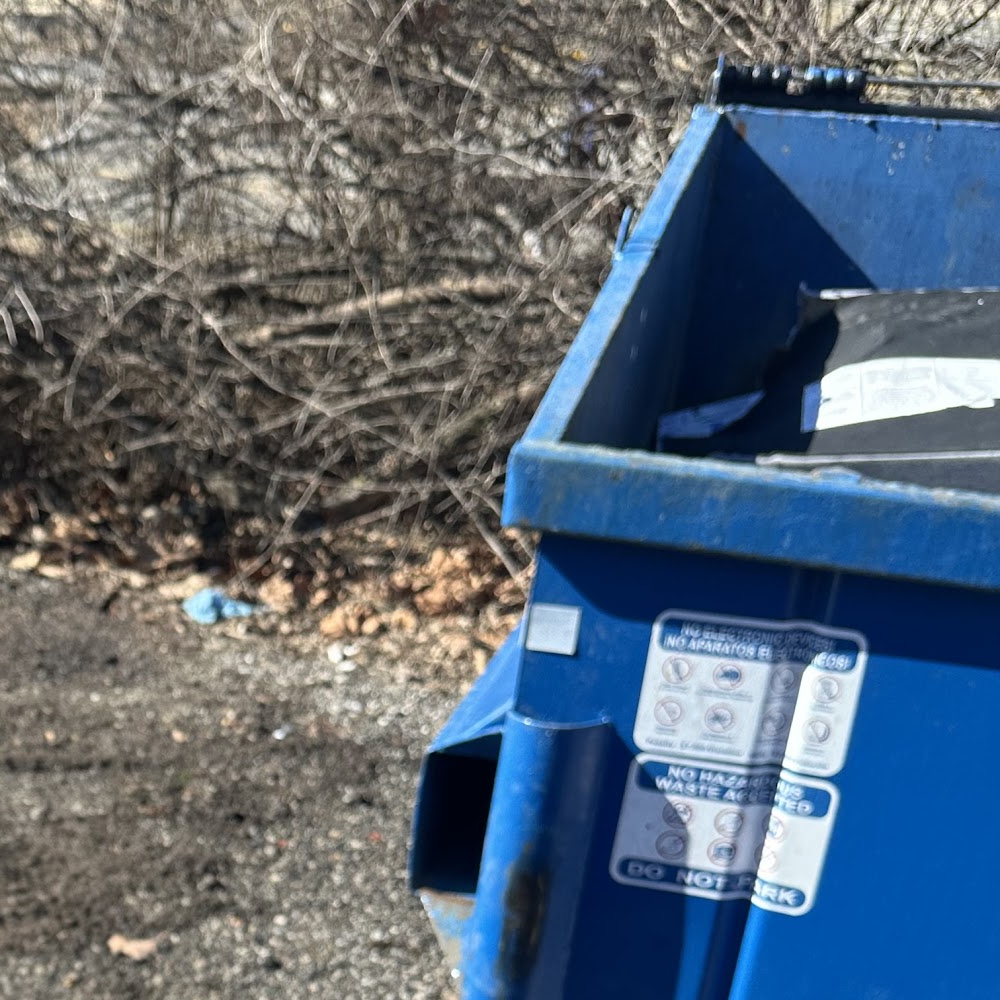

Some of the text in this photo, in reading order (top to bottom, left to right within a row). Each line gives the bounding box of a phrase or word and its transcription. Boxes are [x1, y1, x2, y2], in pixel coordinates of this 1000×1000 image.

[681, 623, 701, 638] NO
[668, 765, 696, 782] NO
[655, 776, 721, 797] WASTE
[627, 861, 665, 880] DO
[676, 867, 727, 890] NOT
